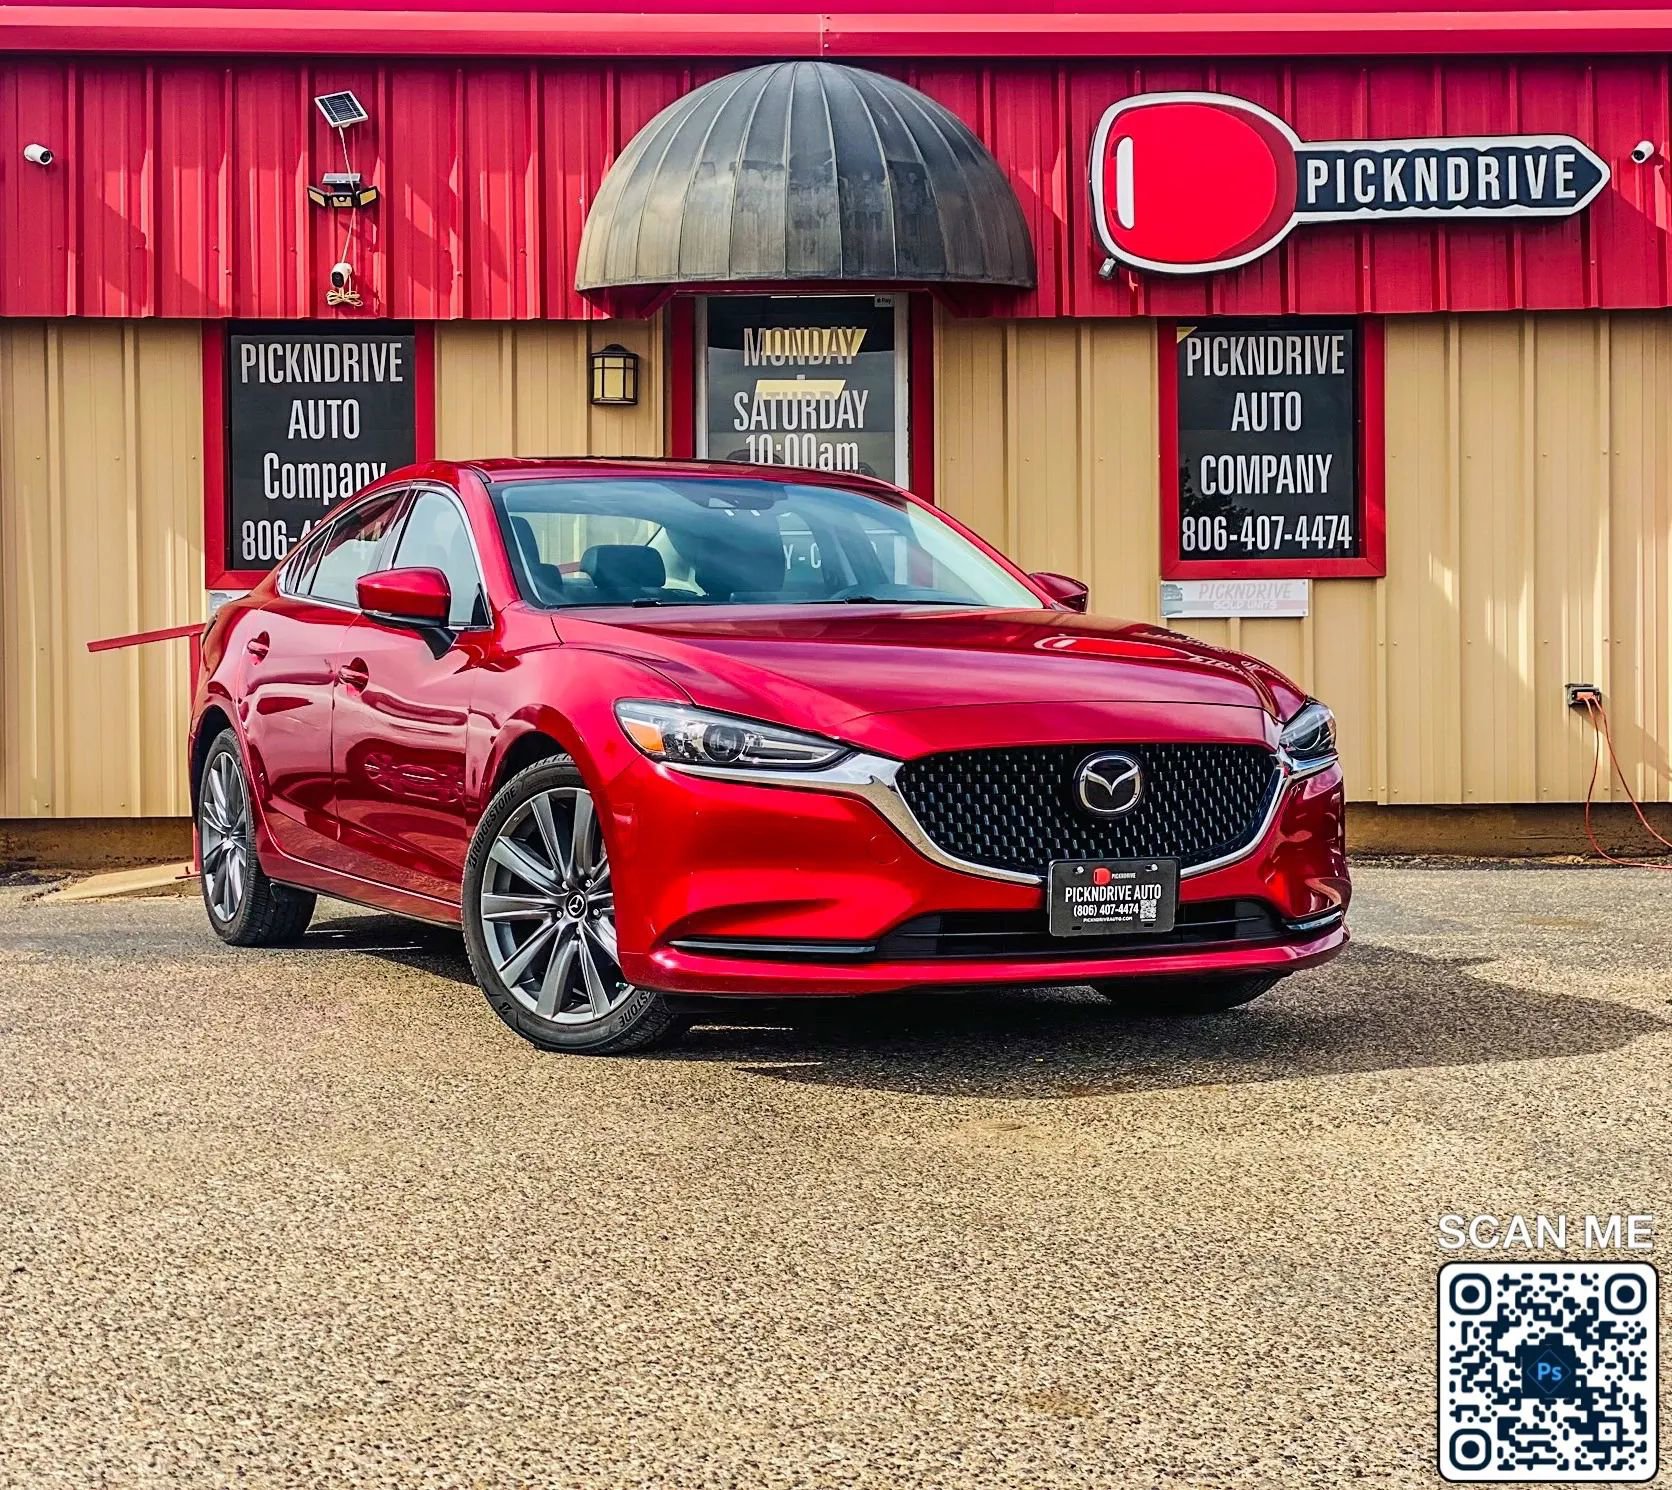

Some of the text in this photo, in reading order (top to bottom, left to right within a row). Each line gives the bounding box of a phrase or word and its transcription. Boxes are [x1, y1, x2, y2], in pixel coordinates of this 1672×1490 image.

[1306, 153, 1577, 203] PICKNDRIVE
[240, 342, 403, 384] PICKNDRIVE
[743, 326, 858, 367] MONDAY
[1186, 335, 1345, 376] PICKNDRIVE
[287, 398, 360, 440] AUTO
[733, 390, 869, 432] SATURDAY
[1231, 391, 1302, 432] AUTO
[1200, 454, 1333, 495] COMPANY
[1182, 515, 1353, 552] 806-407-4474
[1198, 582, 1293, 600] PICKNDRIVE
[1065, 884, 1162, 903] PICKNDRIVE AUTO
[1073, 902, 1139, 917] (806) 407-4474
